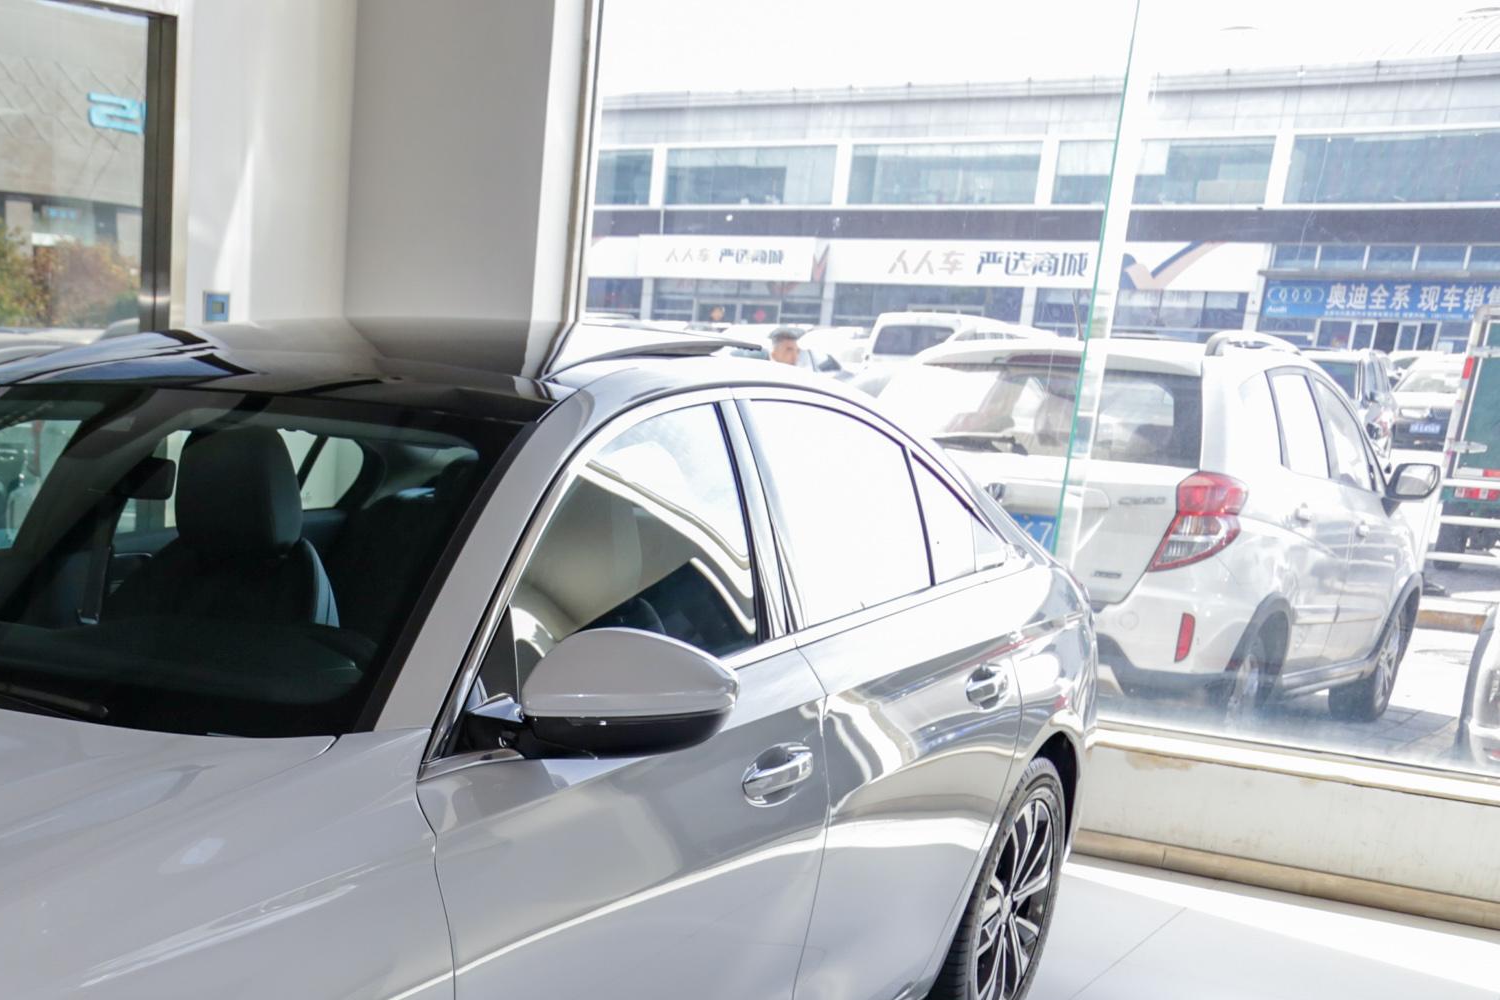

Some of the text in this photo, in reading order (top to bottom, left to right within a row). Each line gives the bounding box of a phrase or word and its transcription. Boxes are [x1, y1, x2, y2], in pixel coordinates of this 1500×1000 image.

[888, 250, 1089, 277] 人人车 严选商城
[1266, 305, 1288, 315] Audi
[1325, 283, 1412, 311] 奥迪全系
